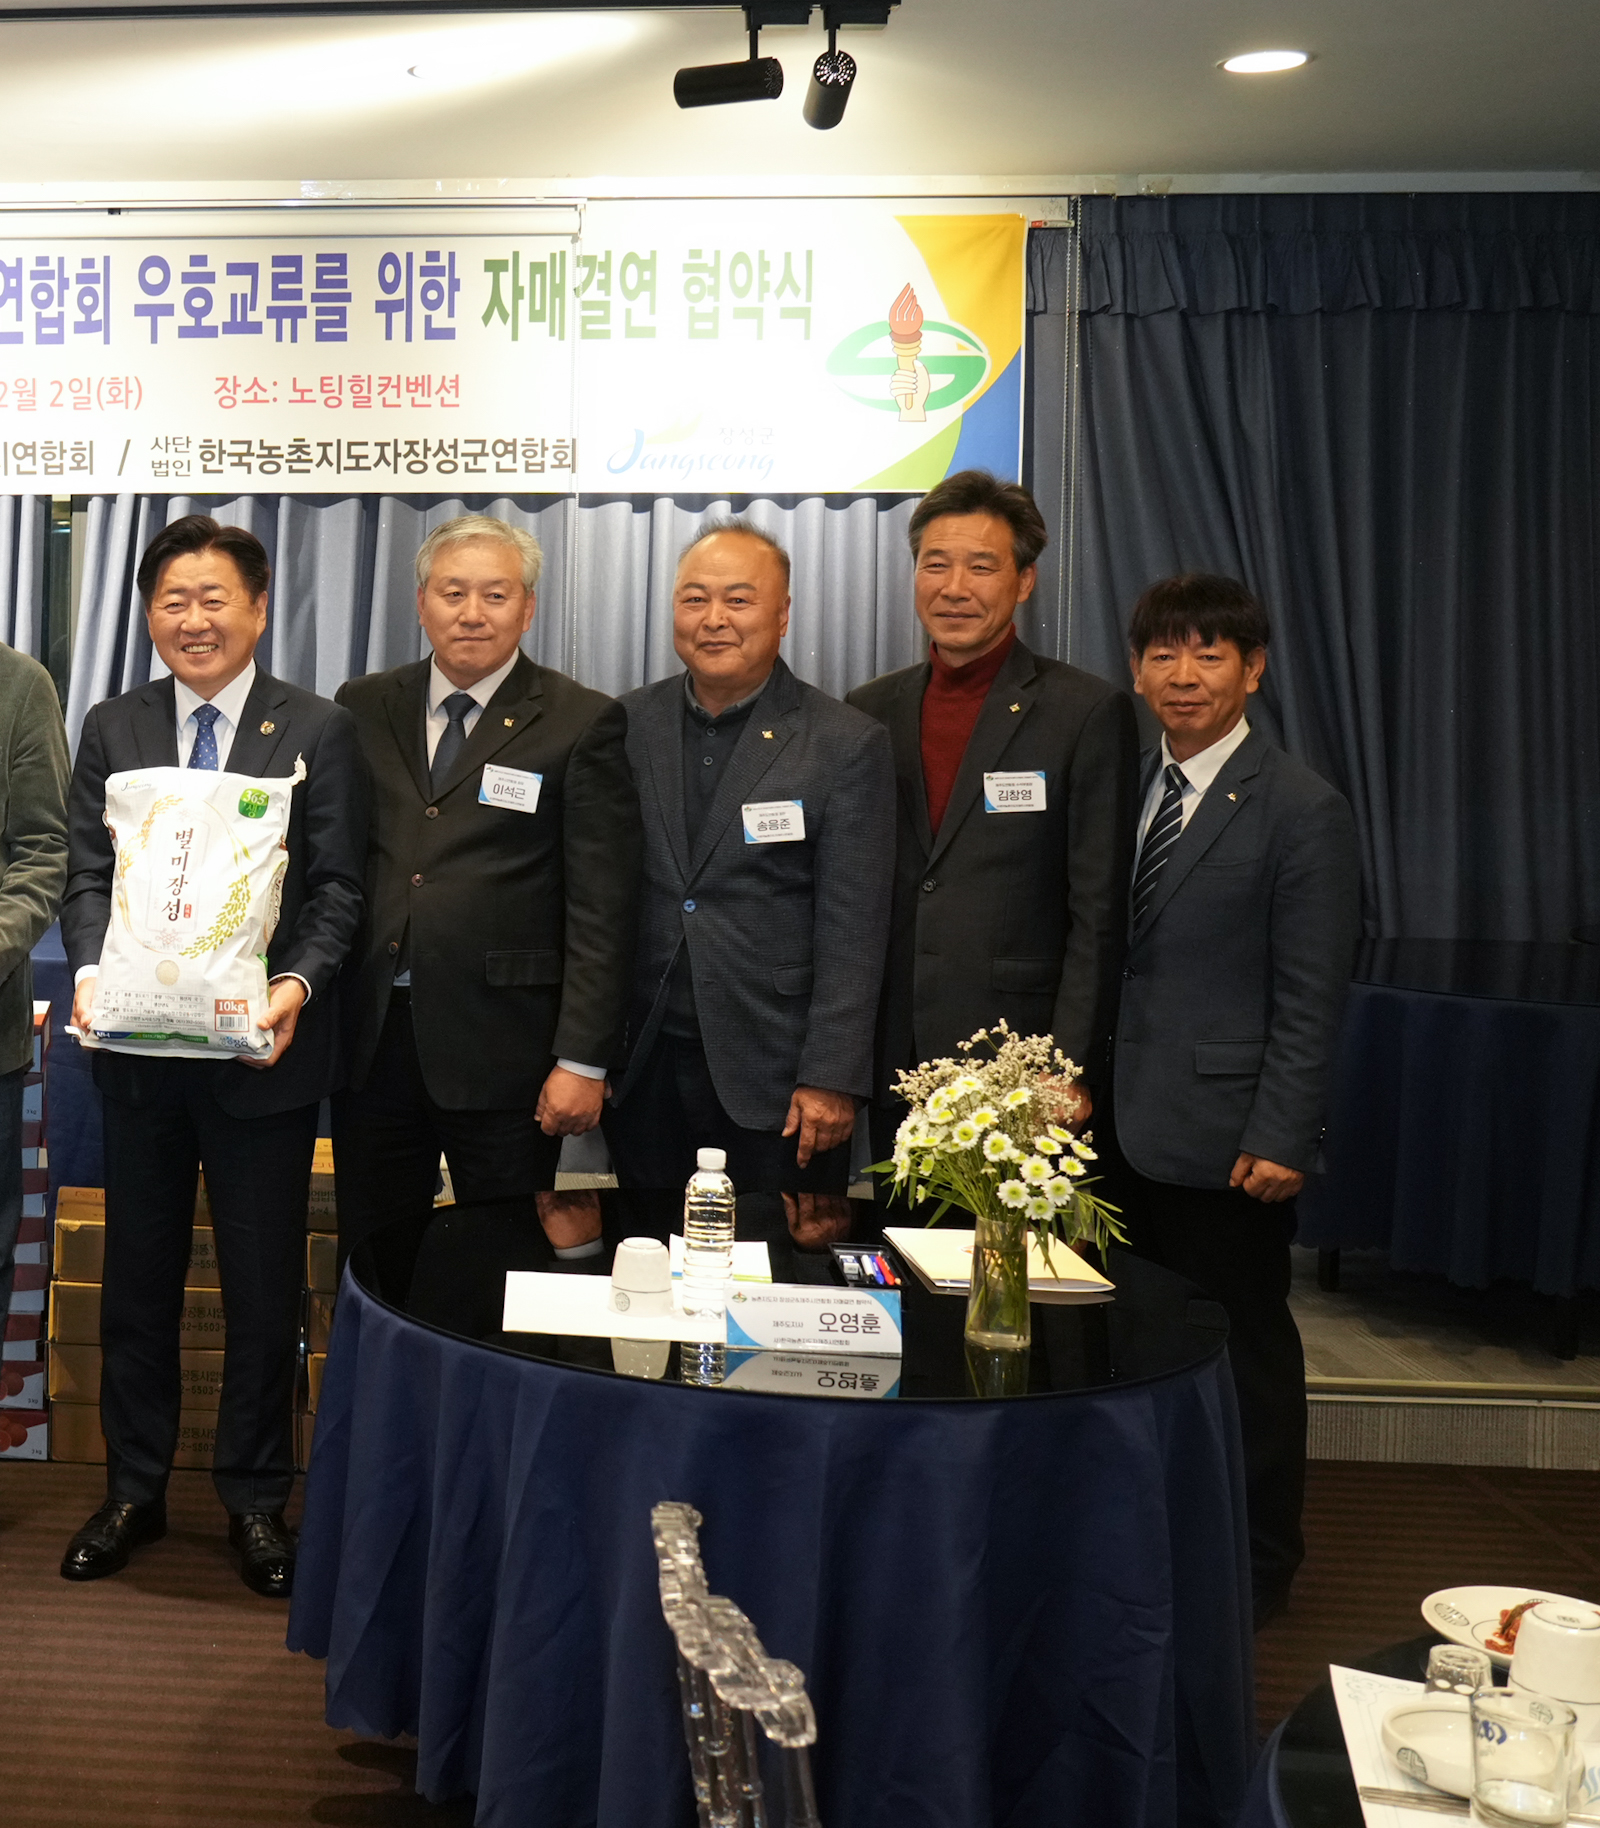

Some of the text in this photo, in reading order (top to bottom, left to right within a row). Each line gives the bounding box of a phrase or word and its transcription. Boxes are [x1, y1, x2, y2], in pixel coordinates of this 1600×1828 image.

[133, 250, 351, 344] 우호교류를
[375, 250, 461, 342] 위한
[482, 249, 659, 341] 자매결연
[682, 248, 815, 340] 협약식
[49, 376, 143, 413] 2일(화)
[213, 376, 280, 409] 장소:
[288, 374, 462, 409] 노팅힐컨벤션
[150, 436, 192, 455] 사단
[198, 437, 577, 475] 한국농촌지도자장성군연합회
[151, 458, 191, 478] 법인
[242, 790, 267, 805] 365
[492, 783, 526, 800] 이석근
[998, 789, 1032, 801] 김창영
[218, 1001, 245, 1014] 10kg
[818, 1312, 881, 1334] 오영훈
